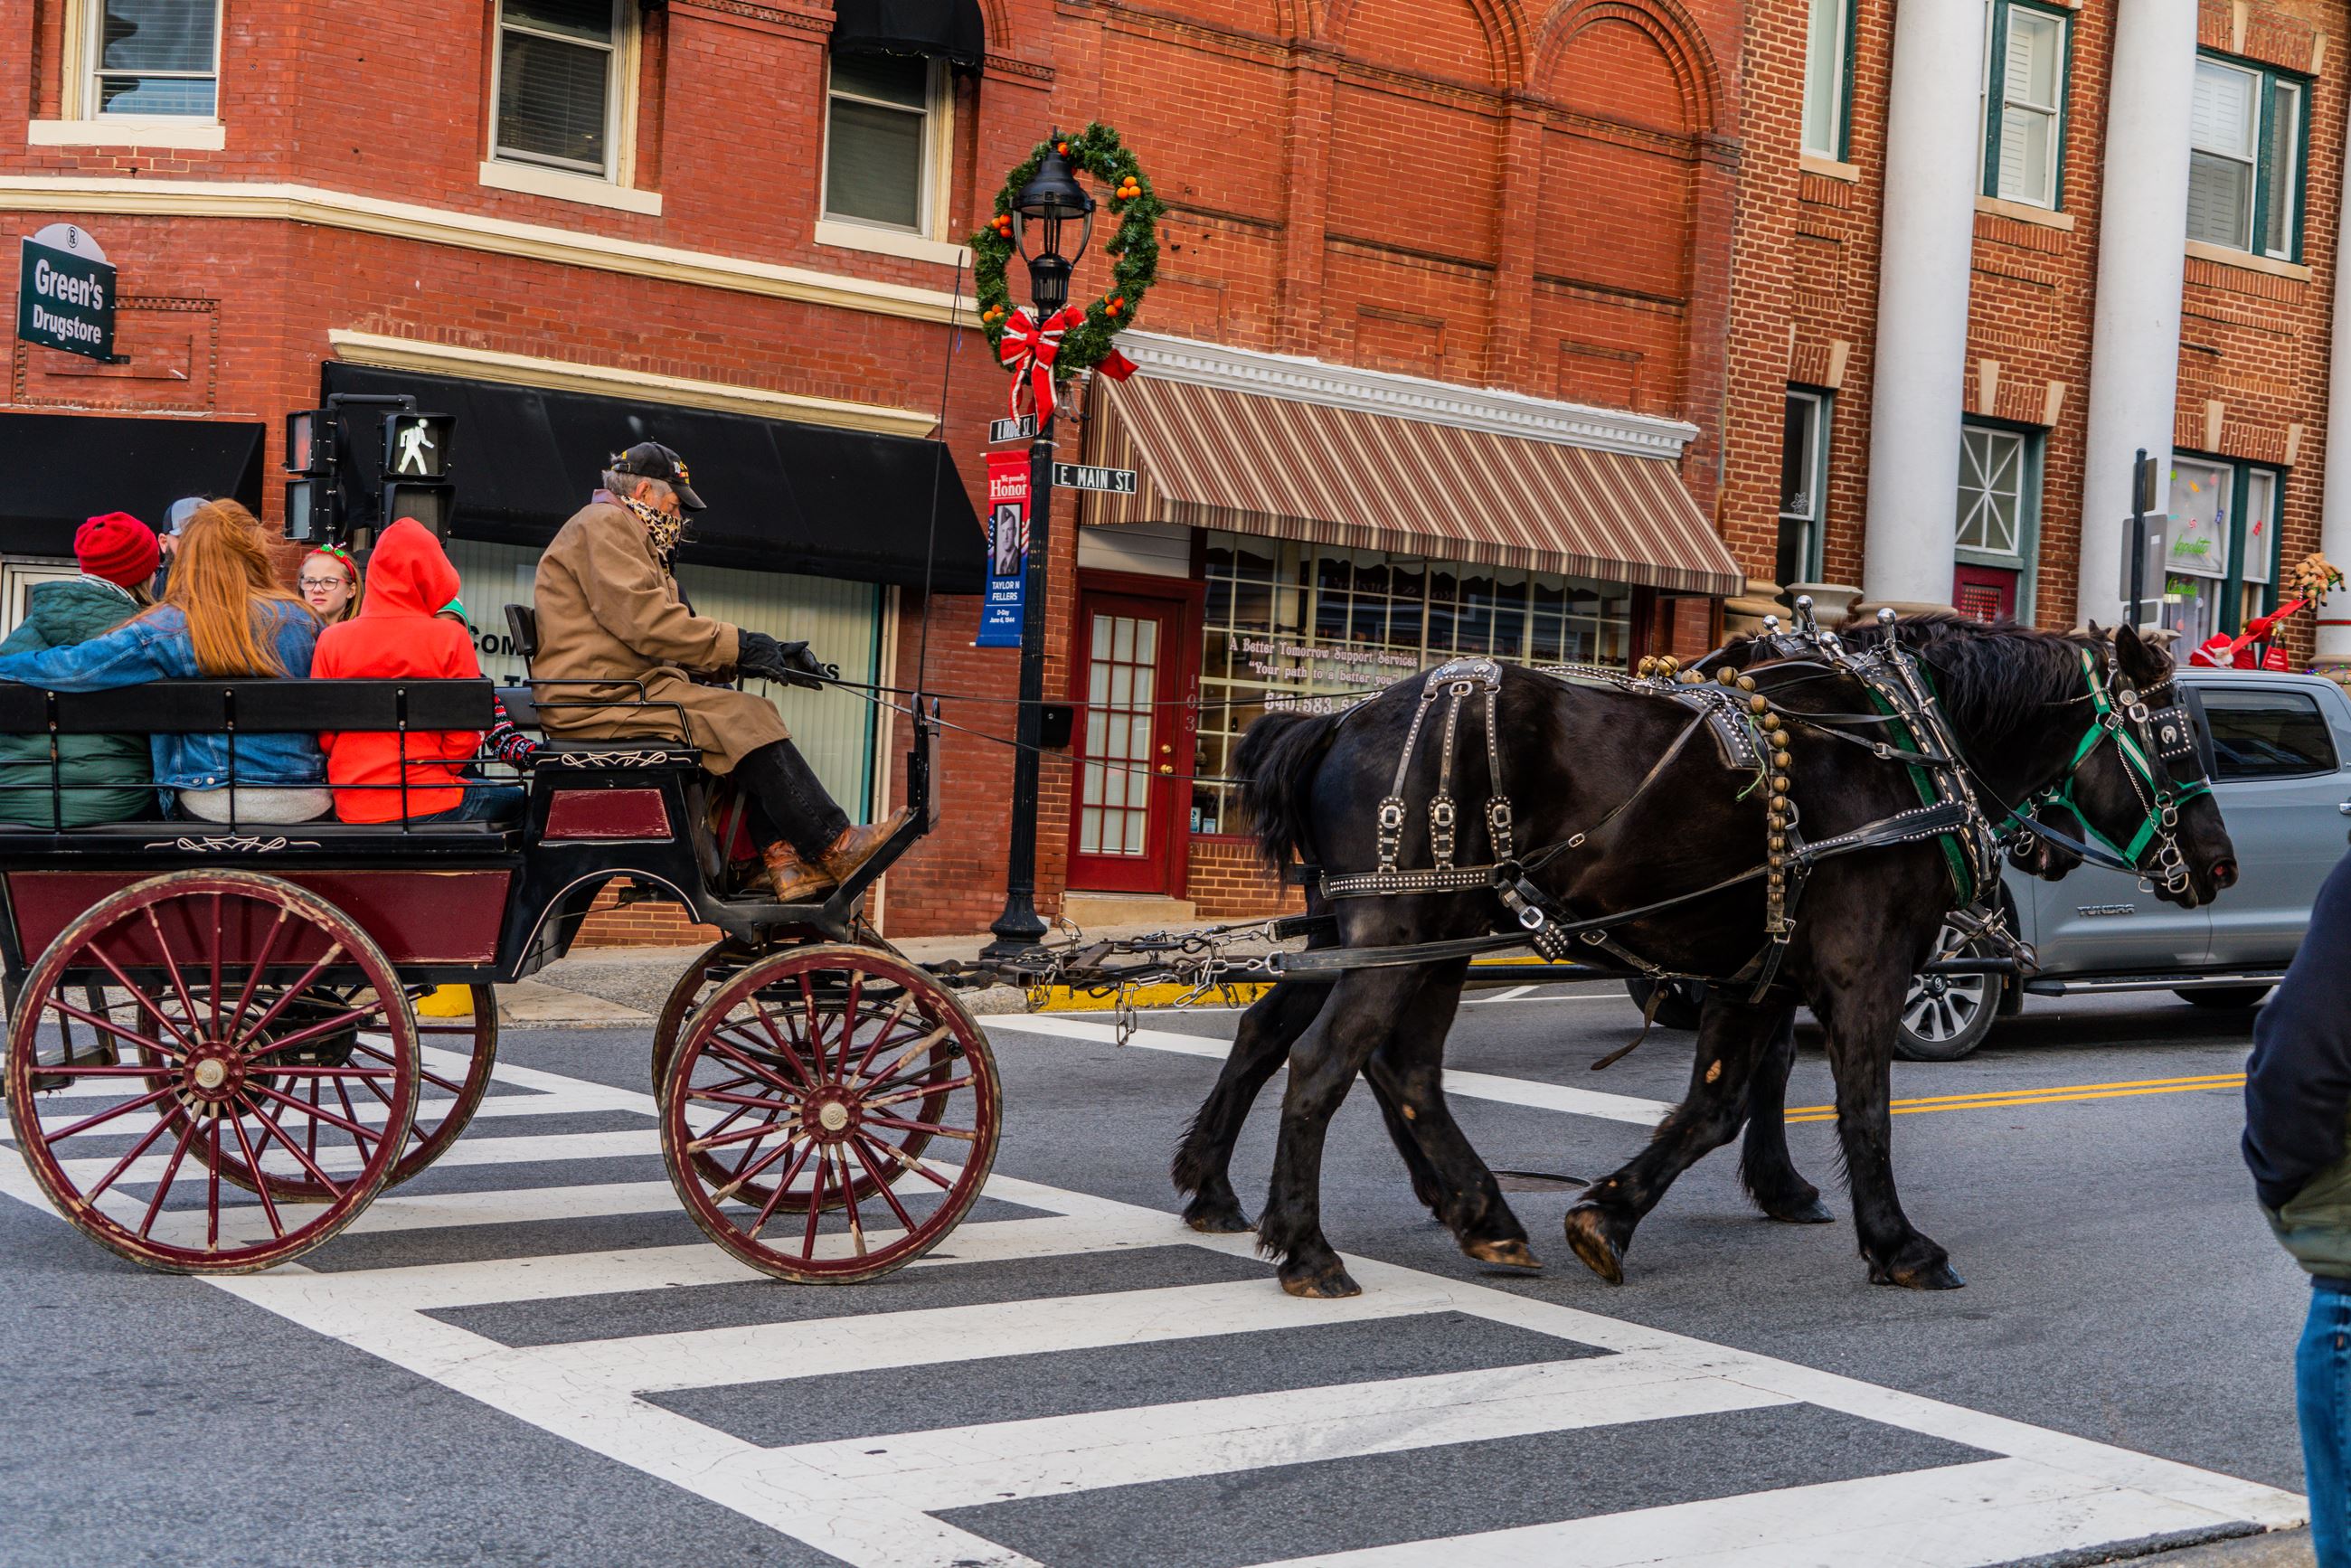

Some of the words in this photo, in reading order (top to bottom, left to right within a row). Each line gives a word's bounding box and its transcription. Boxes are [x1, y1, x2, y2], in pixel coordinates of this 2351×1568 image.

[35, 259, 103, 310] Green's
[33, 303, 102, 345] Drugstore
[990, 479, 1027, 496] Honor
[1061, 467, 1071, 486] E.
[1077, 468, 1109, 489] MAIN
[1116, 472, 1131, 492] ST.
[992, 581, 1015, 590] TAYLOR
[2167, 578, 2199, 600] Candy
[992, 592, 1018, 600] FELLERS
[1229, 638, 1238, 651] A
[1242, 638, 1275, 654] Better
[1279, 641, 1329, 658] Tomorrow
[1334, 647, 1374, 665] Support
[1377, 650, 1418, 667] Services
[1284, 666, 1308, 679] path
[1313, 668, 1323, 679] to
[1328, 670, 1334, 679] a
[1339, 670, 1370, 683] better
[2077, 904, 2134, 915] TUNDRA
